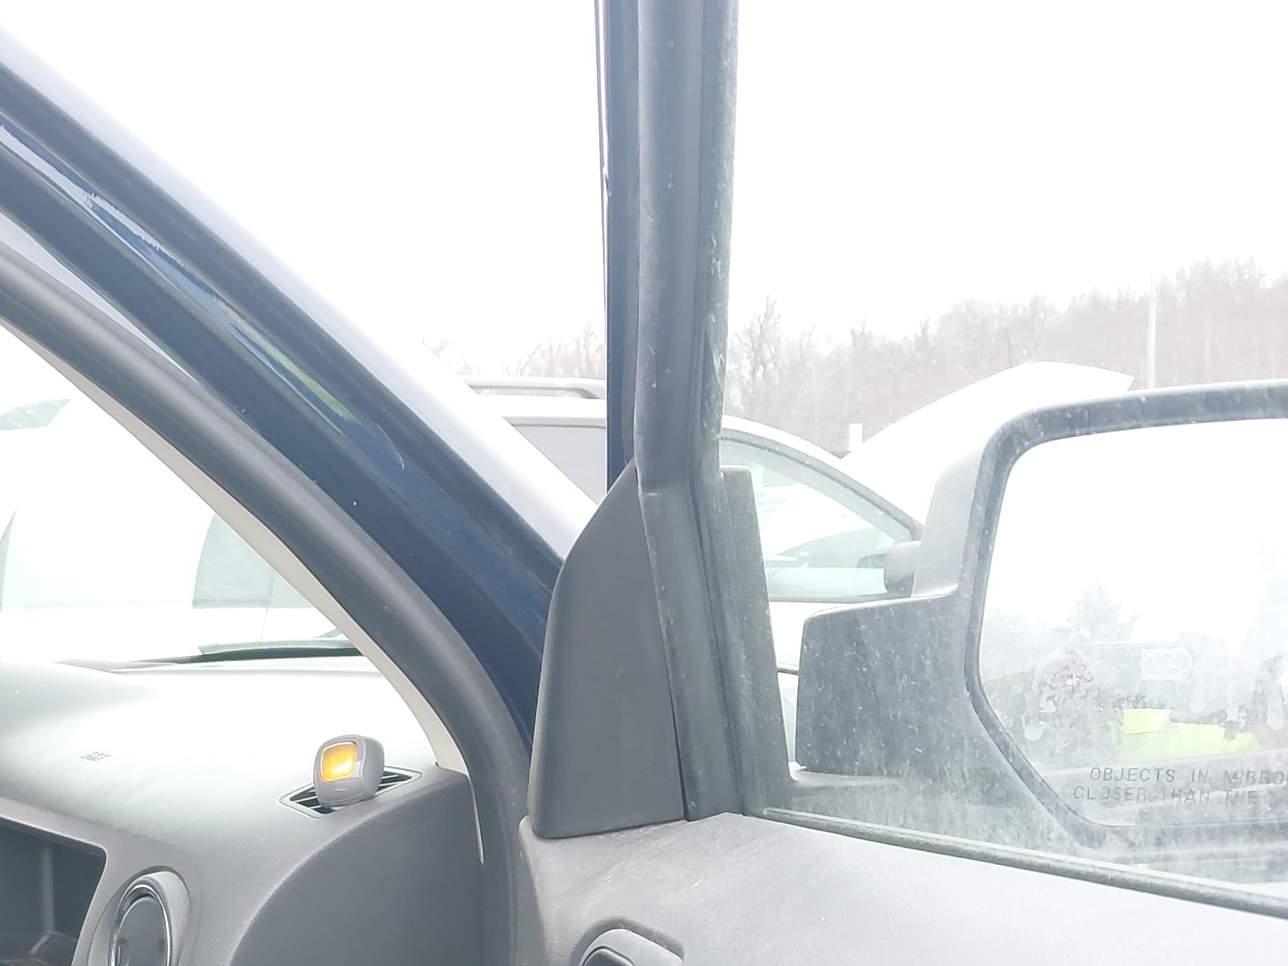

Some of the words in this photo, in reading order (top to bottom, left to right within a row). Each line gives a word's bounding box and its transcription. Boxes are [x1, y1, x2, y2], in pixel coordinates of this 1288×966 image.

[1089, 767, 1176, 783] OBJECTS
[1191, 768, 1209, 784] IN
[1073, 785, 1146, 803] CLOSER
